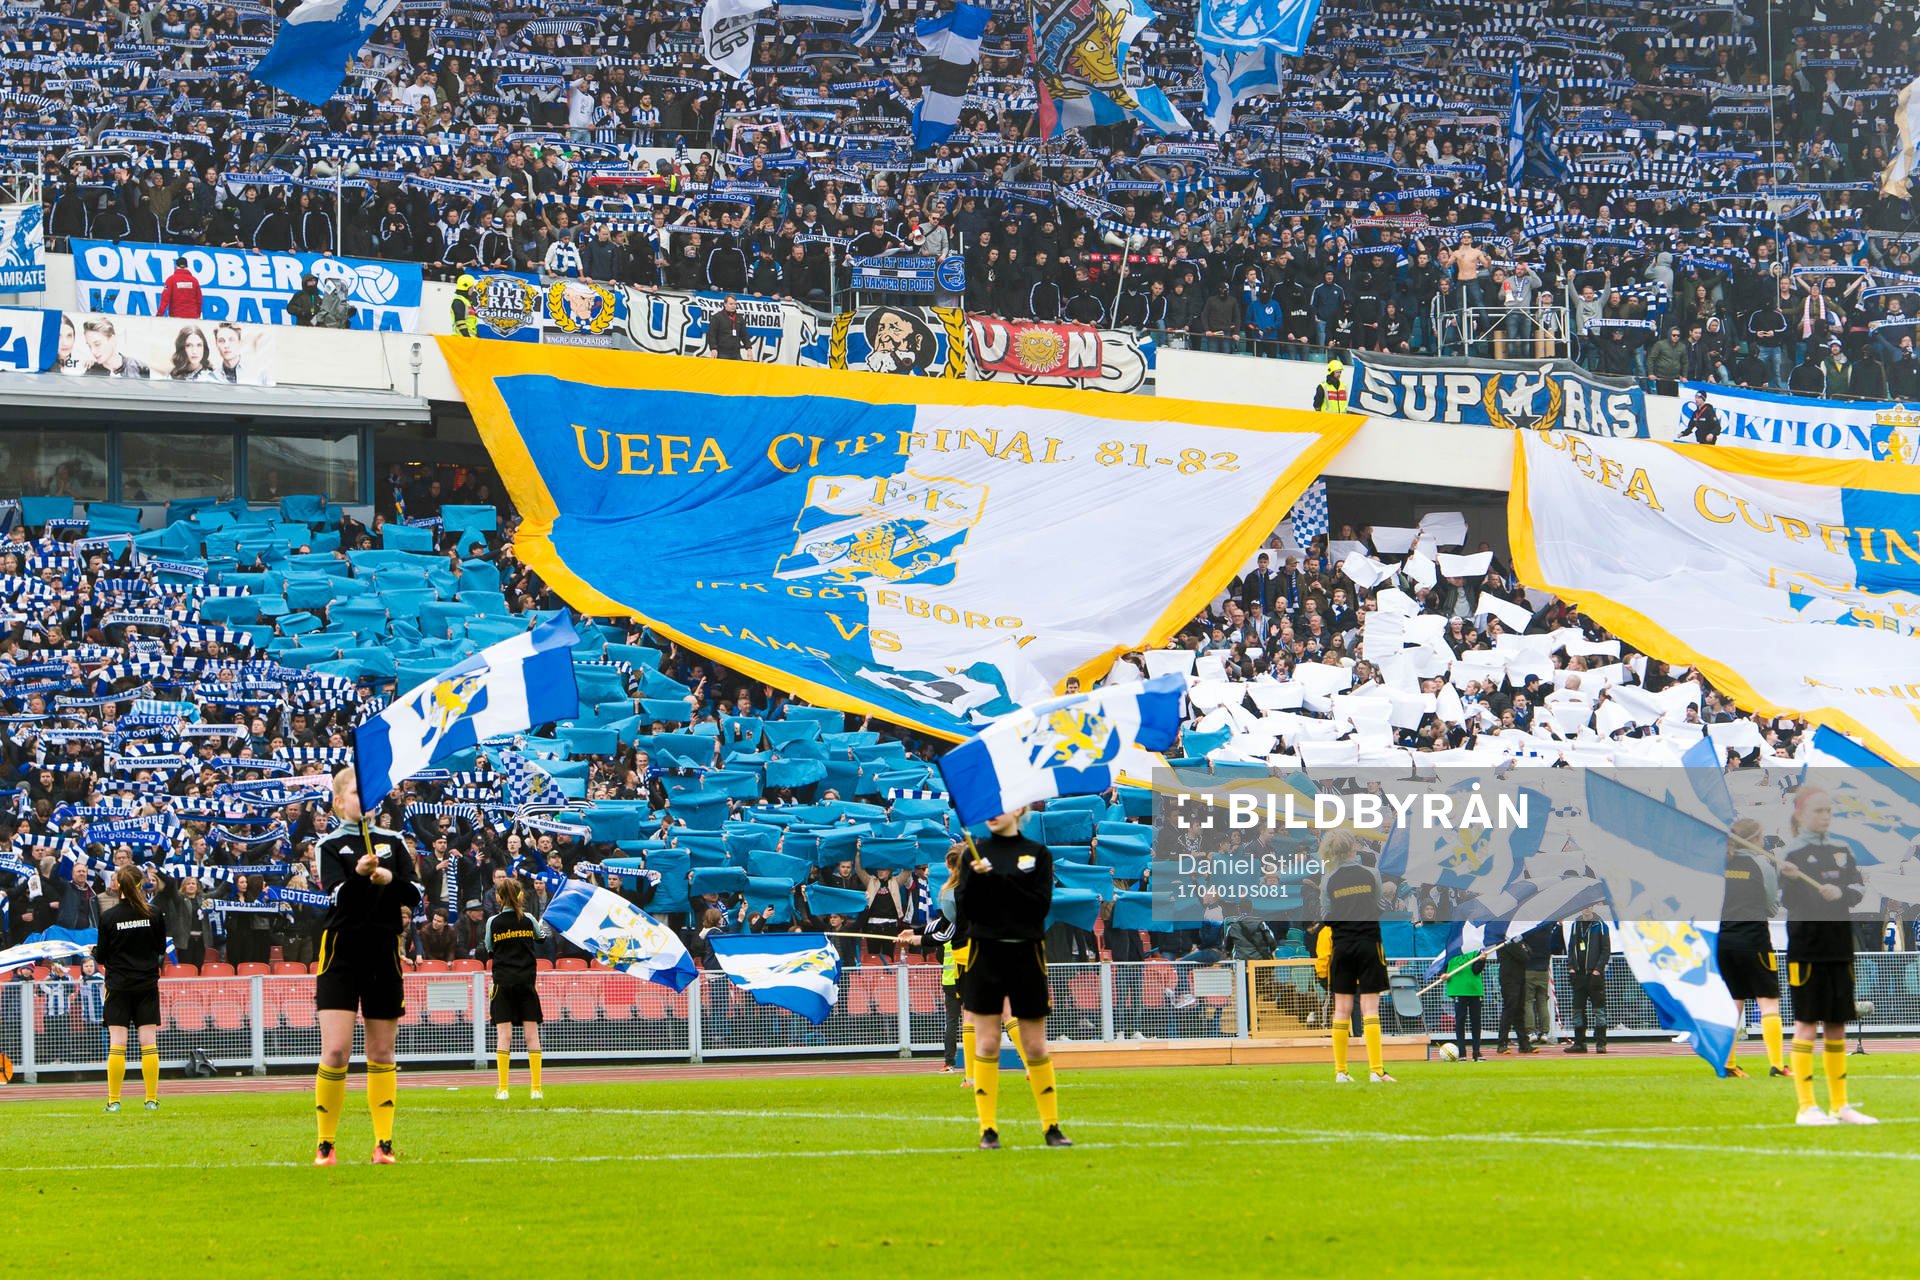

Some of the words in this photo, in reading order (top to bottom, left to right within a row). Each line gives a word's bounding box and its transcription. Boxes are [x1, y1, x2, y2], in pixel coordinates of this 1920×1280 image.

[84, 246, 306, 290] OKTOBER
[910, 279, 935, 291] POLIS
[757, 303, 781, 313] FÖR
[571, 424, 733, 475] UEFA
[1094, 440, 1242, 475] 81-82
[108, 833, 156, 844] göteborg
[493, 928, 534, 943] Sandersson
